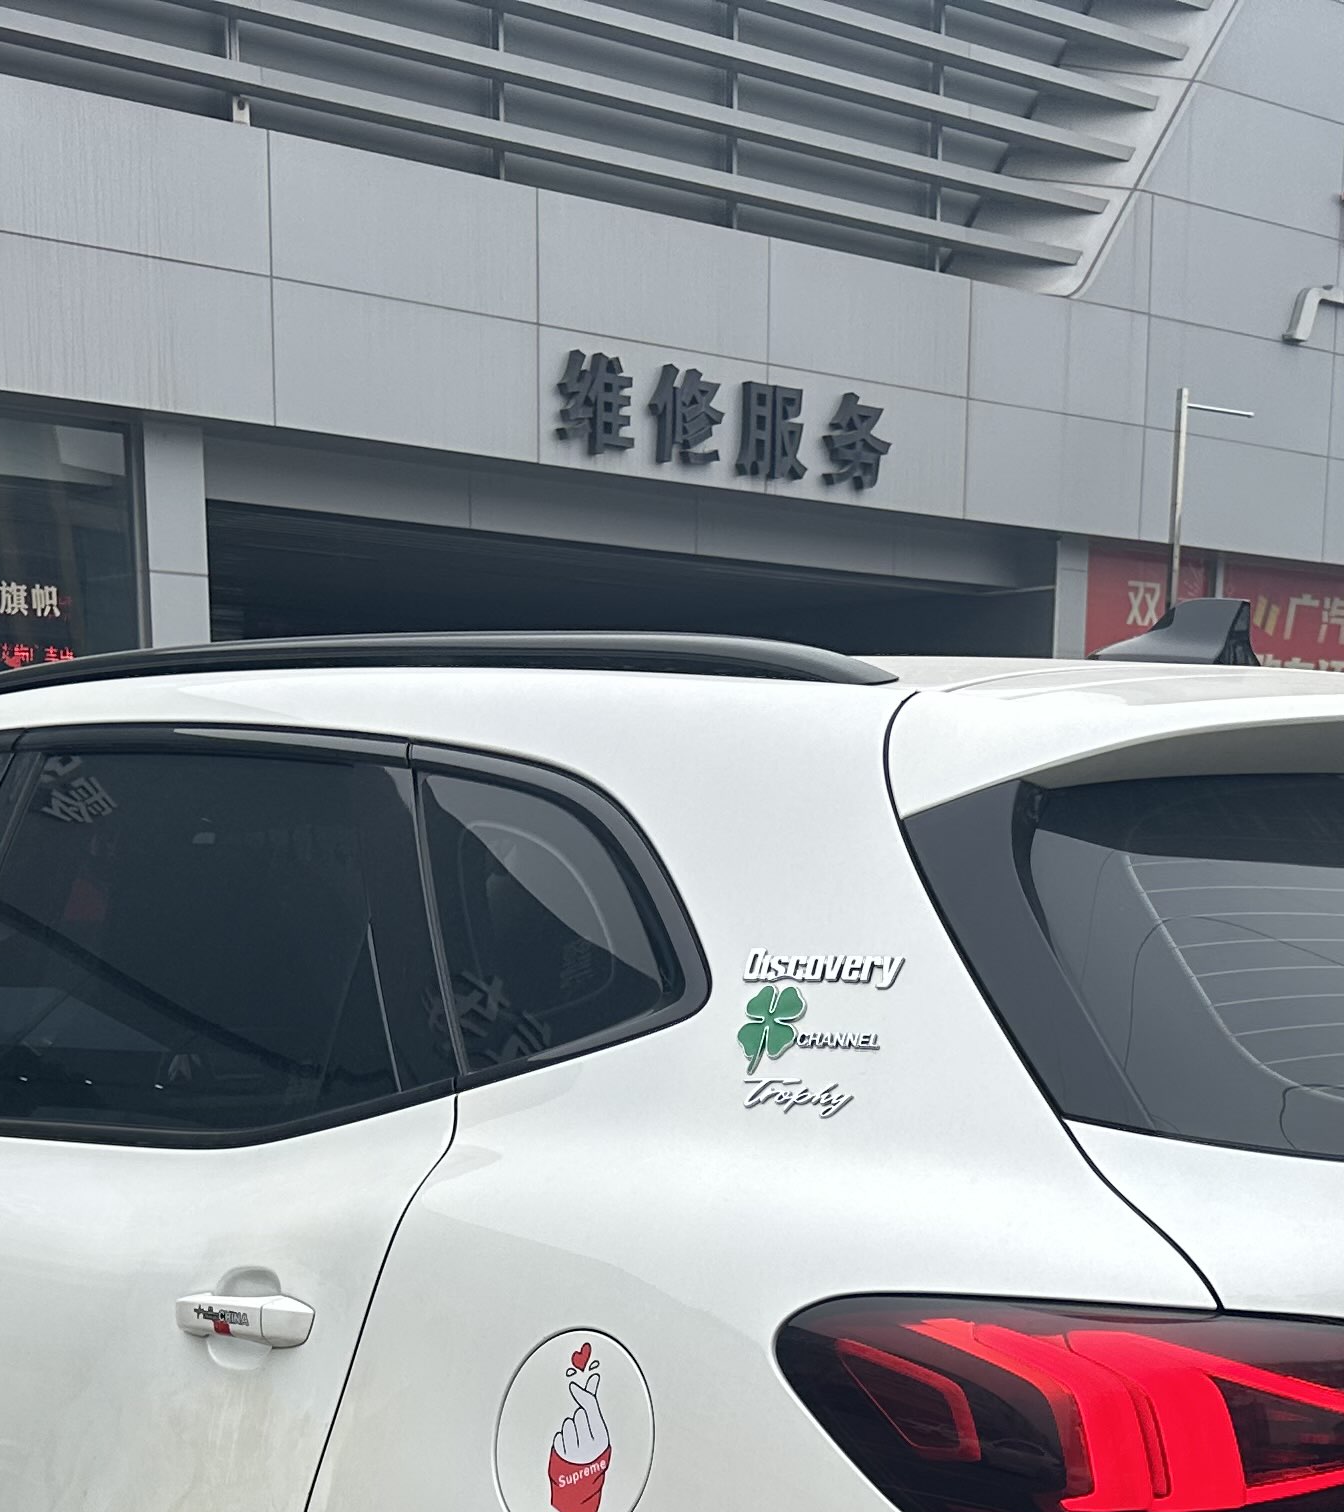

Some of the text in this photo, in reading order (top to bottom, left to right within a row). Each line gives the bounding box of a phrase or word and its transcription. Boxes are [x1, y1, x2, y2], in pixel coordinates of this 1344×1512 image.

[556, 348, 892, 490] 维修服务
[743, 947, 906, 990] Discovery
[795, 1031, 881, 1051] CHANNEL
[743, 1077, 855, 1119] Trophy
[558, 1458, 607, 1488] Supreme
